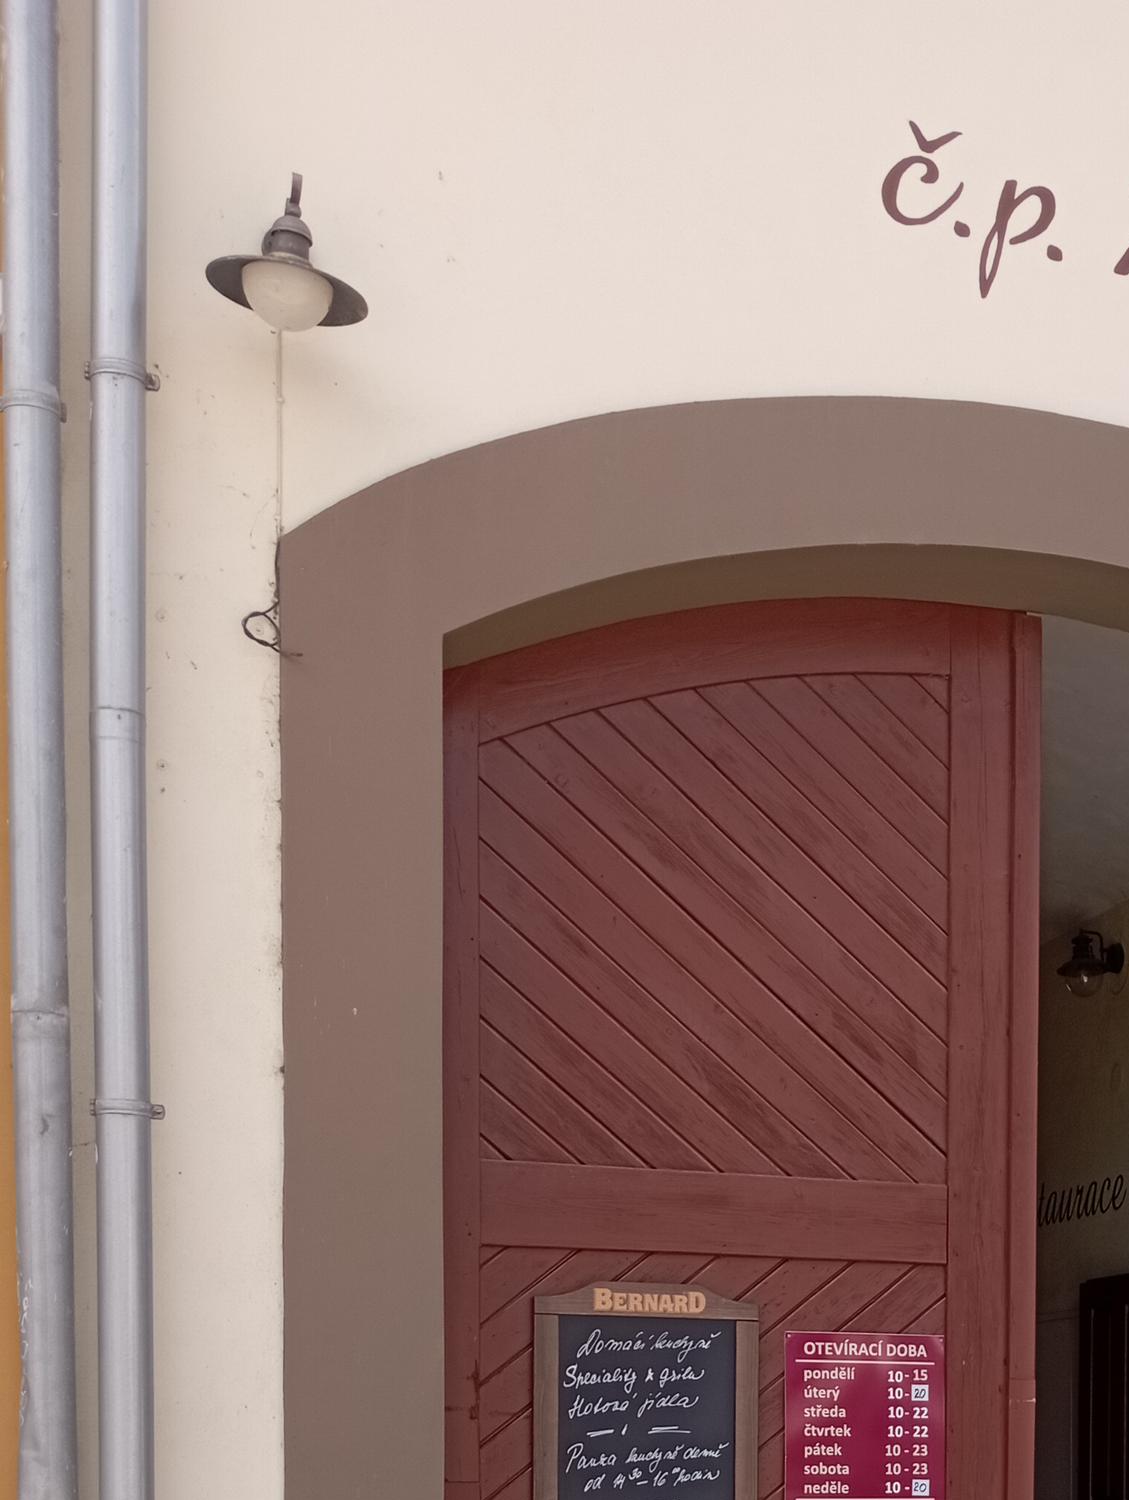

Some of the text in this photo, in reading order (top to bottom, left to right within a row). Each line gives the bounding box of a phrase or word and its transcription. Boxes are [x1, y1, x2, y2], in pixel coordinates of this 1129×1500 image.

[881, 119, 1063, 299] č.p.
[592, 1287, 706, 1313] BERNARD
[803, 1340, 927, 1357] OTEVÍRACÍ DOBA
[563, 1363, 637, 1394] Speciality
[803, 1366, 855, 1383] pondělí
[803, 1385, 840, 1401] úterý
[637, 1392, 699, 1418] jídla
[803, 1405, 846, 1418] středa
[803, 1423, 852, 1438] čtvrtek
[803, 1443, 842, 1459] pátek
[803, 1462, 849, 1475] sobota
[584, 1474, 606, 1493] od
[803, 1481, 849, 1494] neděle
